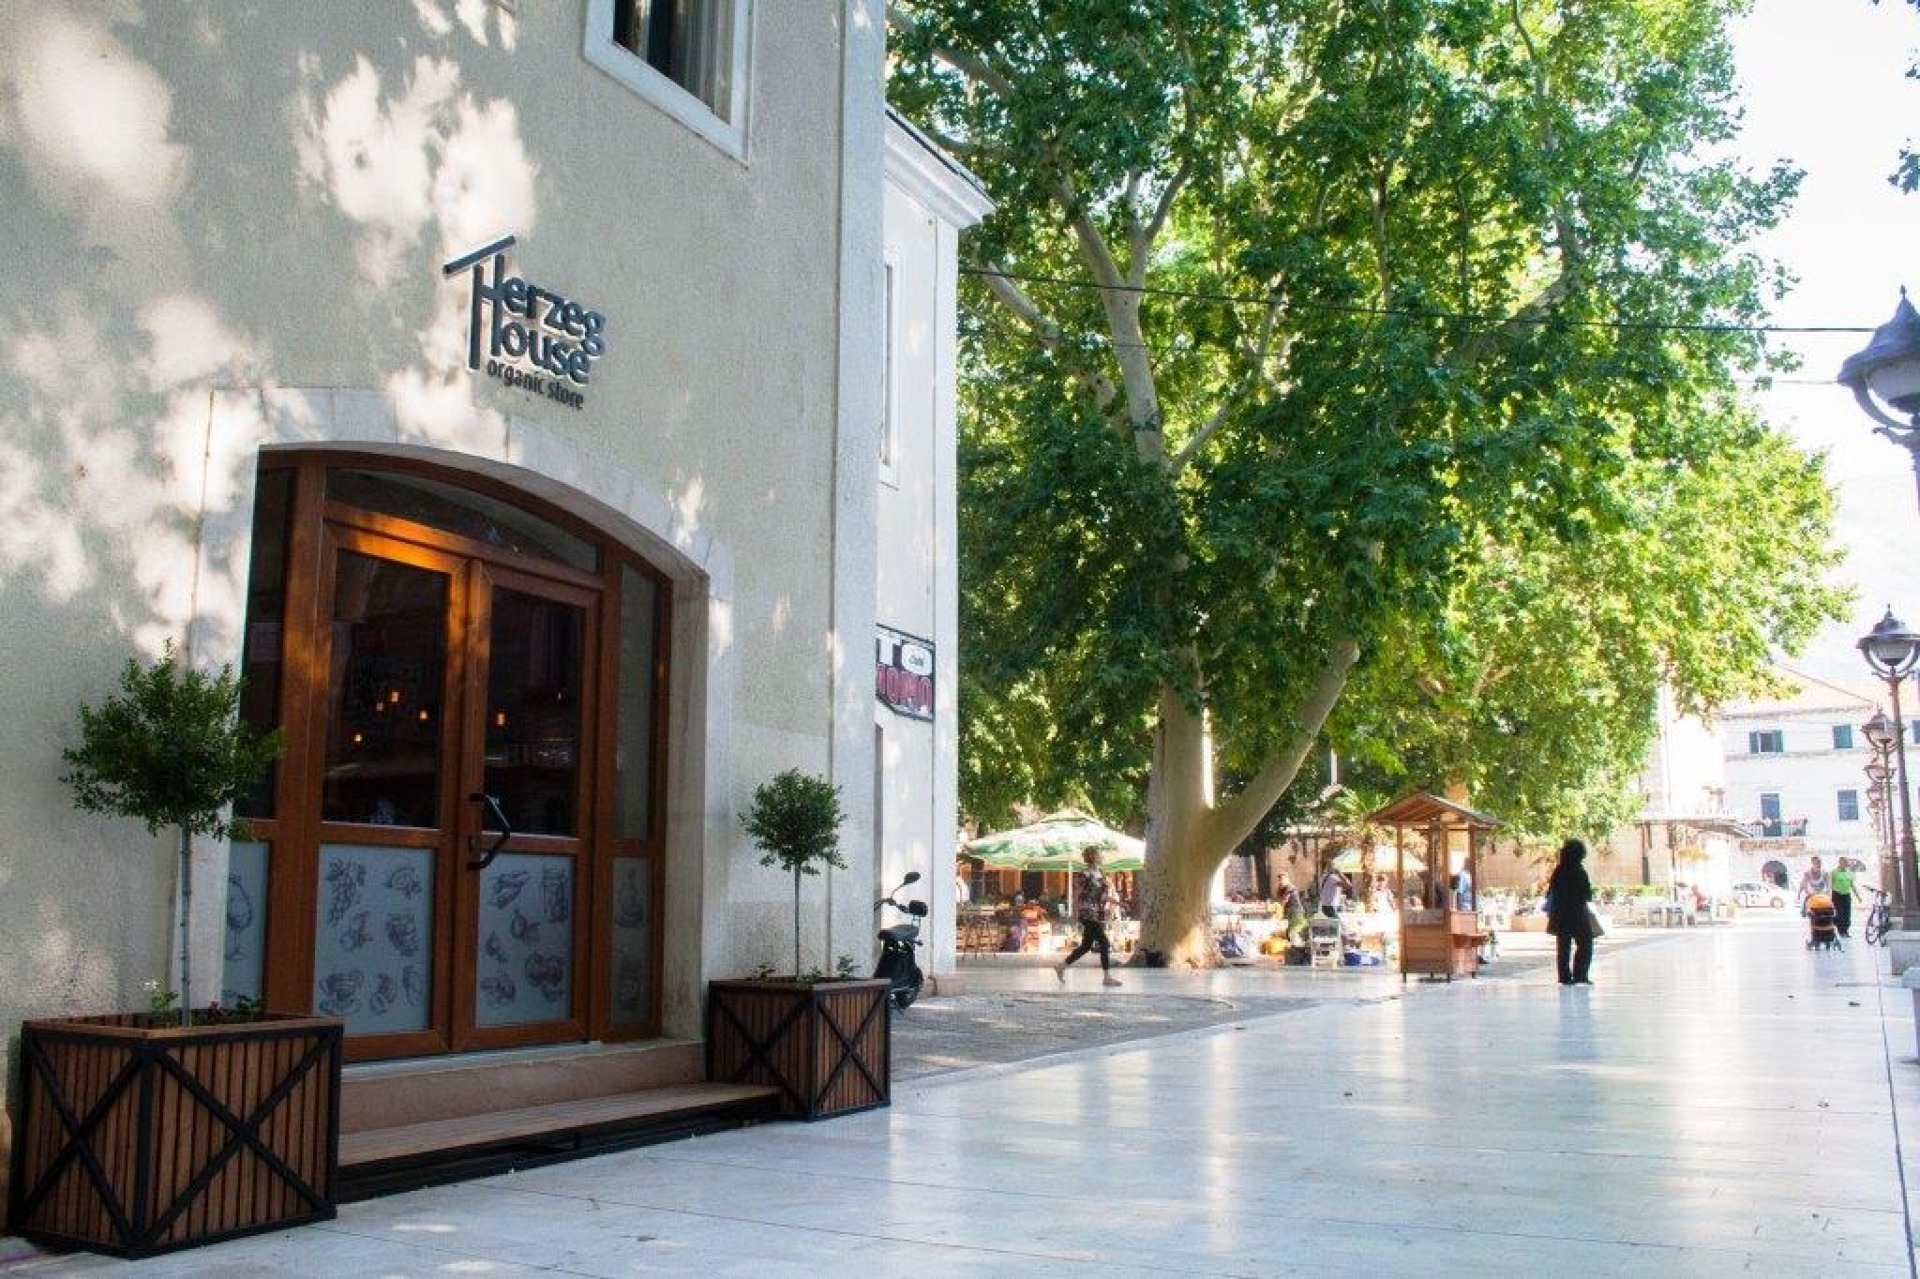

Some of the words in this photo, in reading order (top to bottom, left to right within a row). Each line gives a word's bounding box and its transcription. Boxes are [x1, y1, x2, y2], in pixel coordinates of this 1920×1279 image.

[469, 252, 606, 357] Herzeg
[487, 359, 543, 394] organic
[547, 381, 584, 410] store
